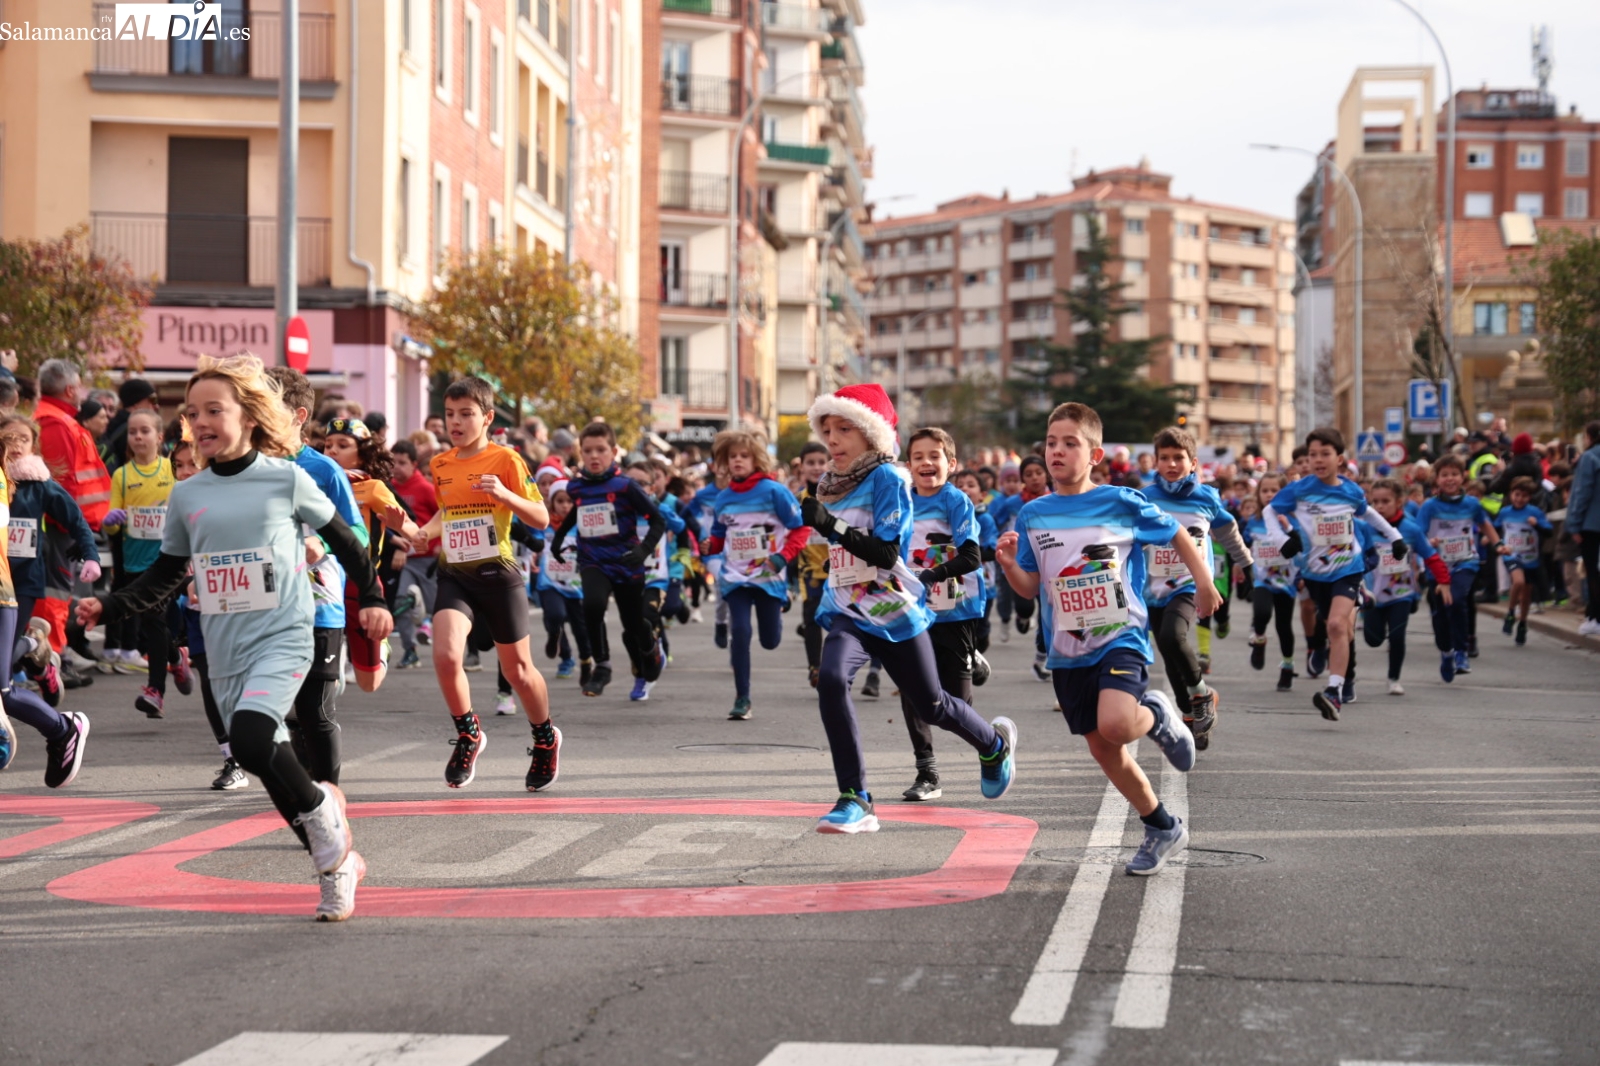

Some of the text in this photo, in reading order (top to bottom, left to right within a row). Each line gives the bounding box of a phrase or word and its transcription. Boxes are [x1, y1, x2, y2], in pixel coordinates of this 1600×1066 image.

[157, 313, 269, 350] Pimpin
[8, 520, 33, 528] ETEL
[133, 514, 161, 528] 6747
[451, 518, 488, 530] SETEL
[583, 512, 605, 527] 6816
[8, 528, 26, 544] 47
[449, 529, 480, 549] 6719
[210, 551, 264, 566] SETEL
[206, 566, 250, 593] 6714
[1066, 573, 1114, 589] SETEL
[1059, 586, 1108, 613] 6983
